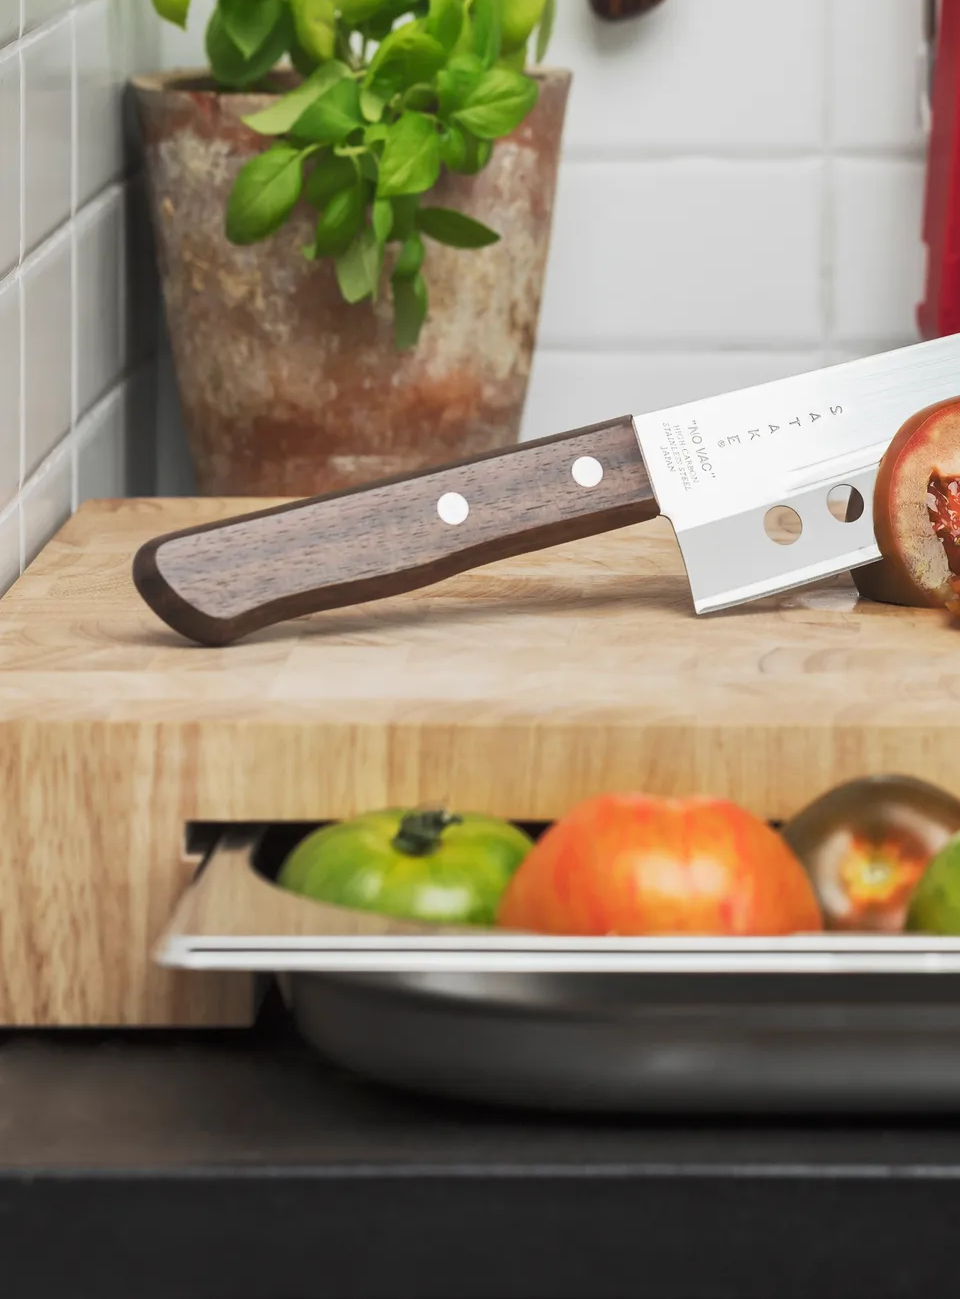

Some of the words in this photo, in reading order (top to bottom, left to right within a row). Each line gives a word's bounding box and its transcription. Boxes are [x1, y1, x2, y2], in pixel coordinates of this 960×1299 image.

[659, 445, 676, 472] JAPAN
[662, 422, 683, 465] STAINLESS
[678, 467, 692, 491] STEEL
[681, 448, 700, 483] CARBON
